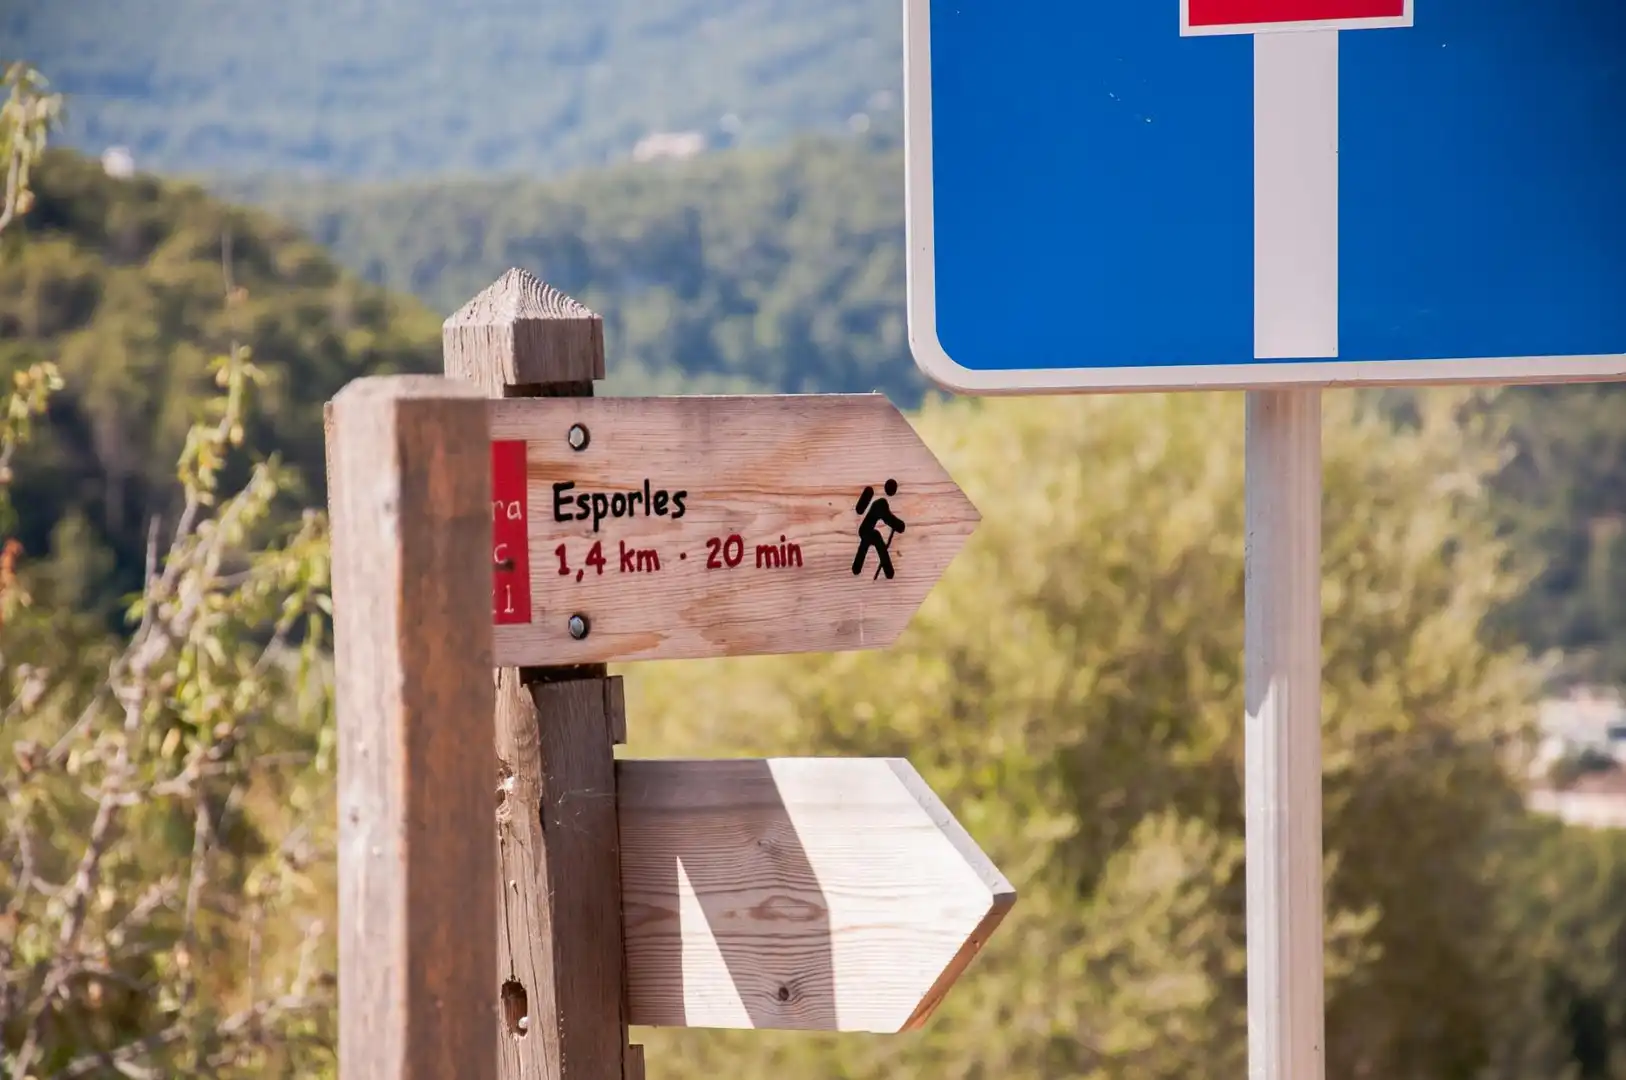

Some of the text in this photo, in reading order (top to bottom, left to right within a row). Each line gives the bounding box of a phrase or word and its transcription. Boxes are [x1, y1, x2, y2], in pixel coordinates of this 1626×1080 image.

[552, 478, 688, 532] Esporles
[555, 540, 607, 582] 1,4
[619, 540, 661, 573] km
[705, 533, 744, 569] 20
[755, 534, 804, 569] min
